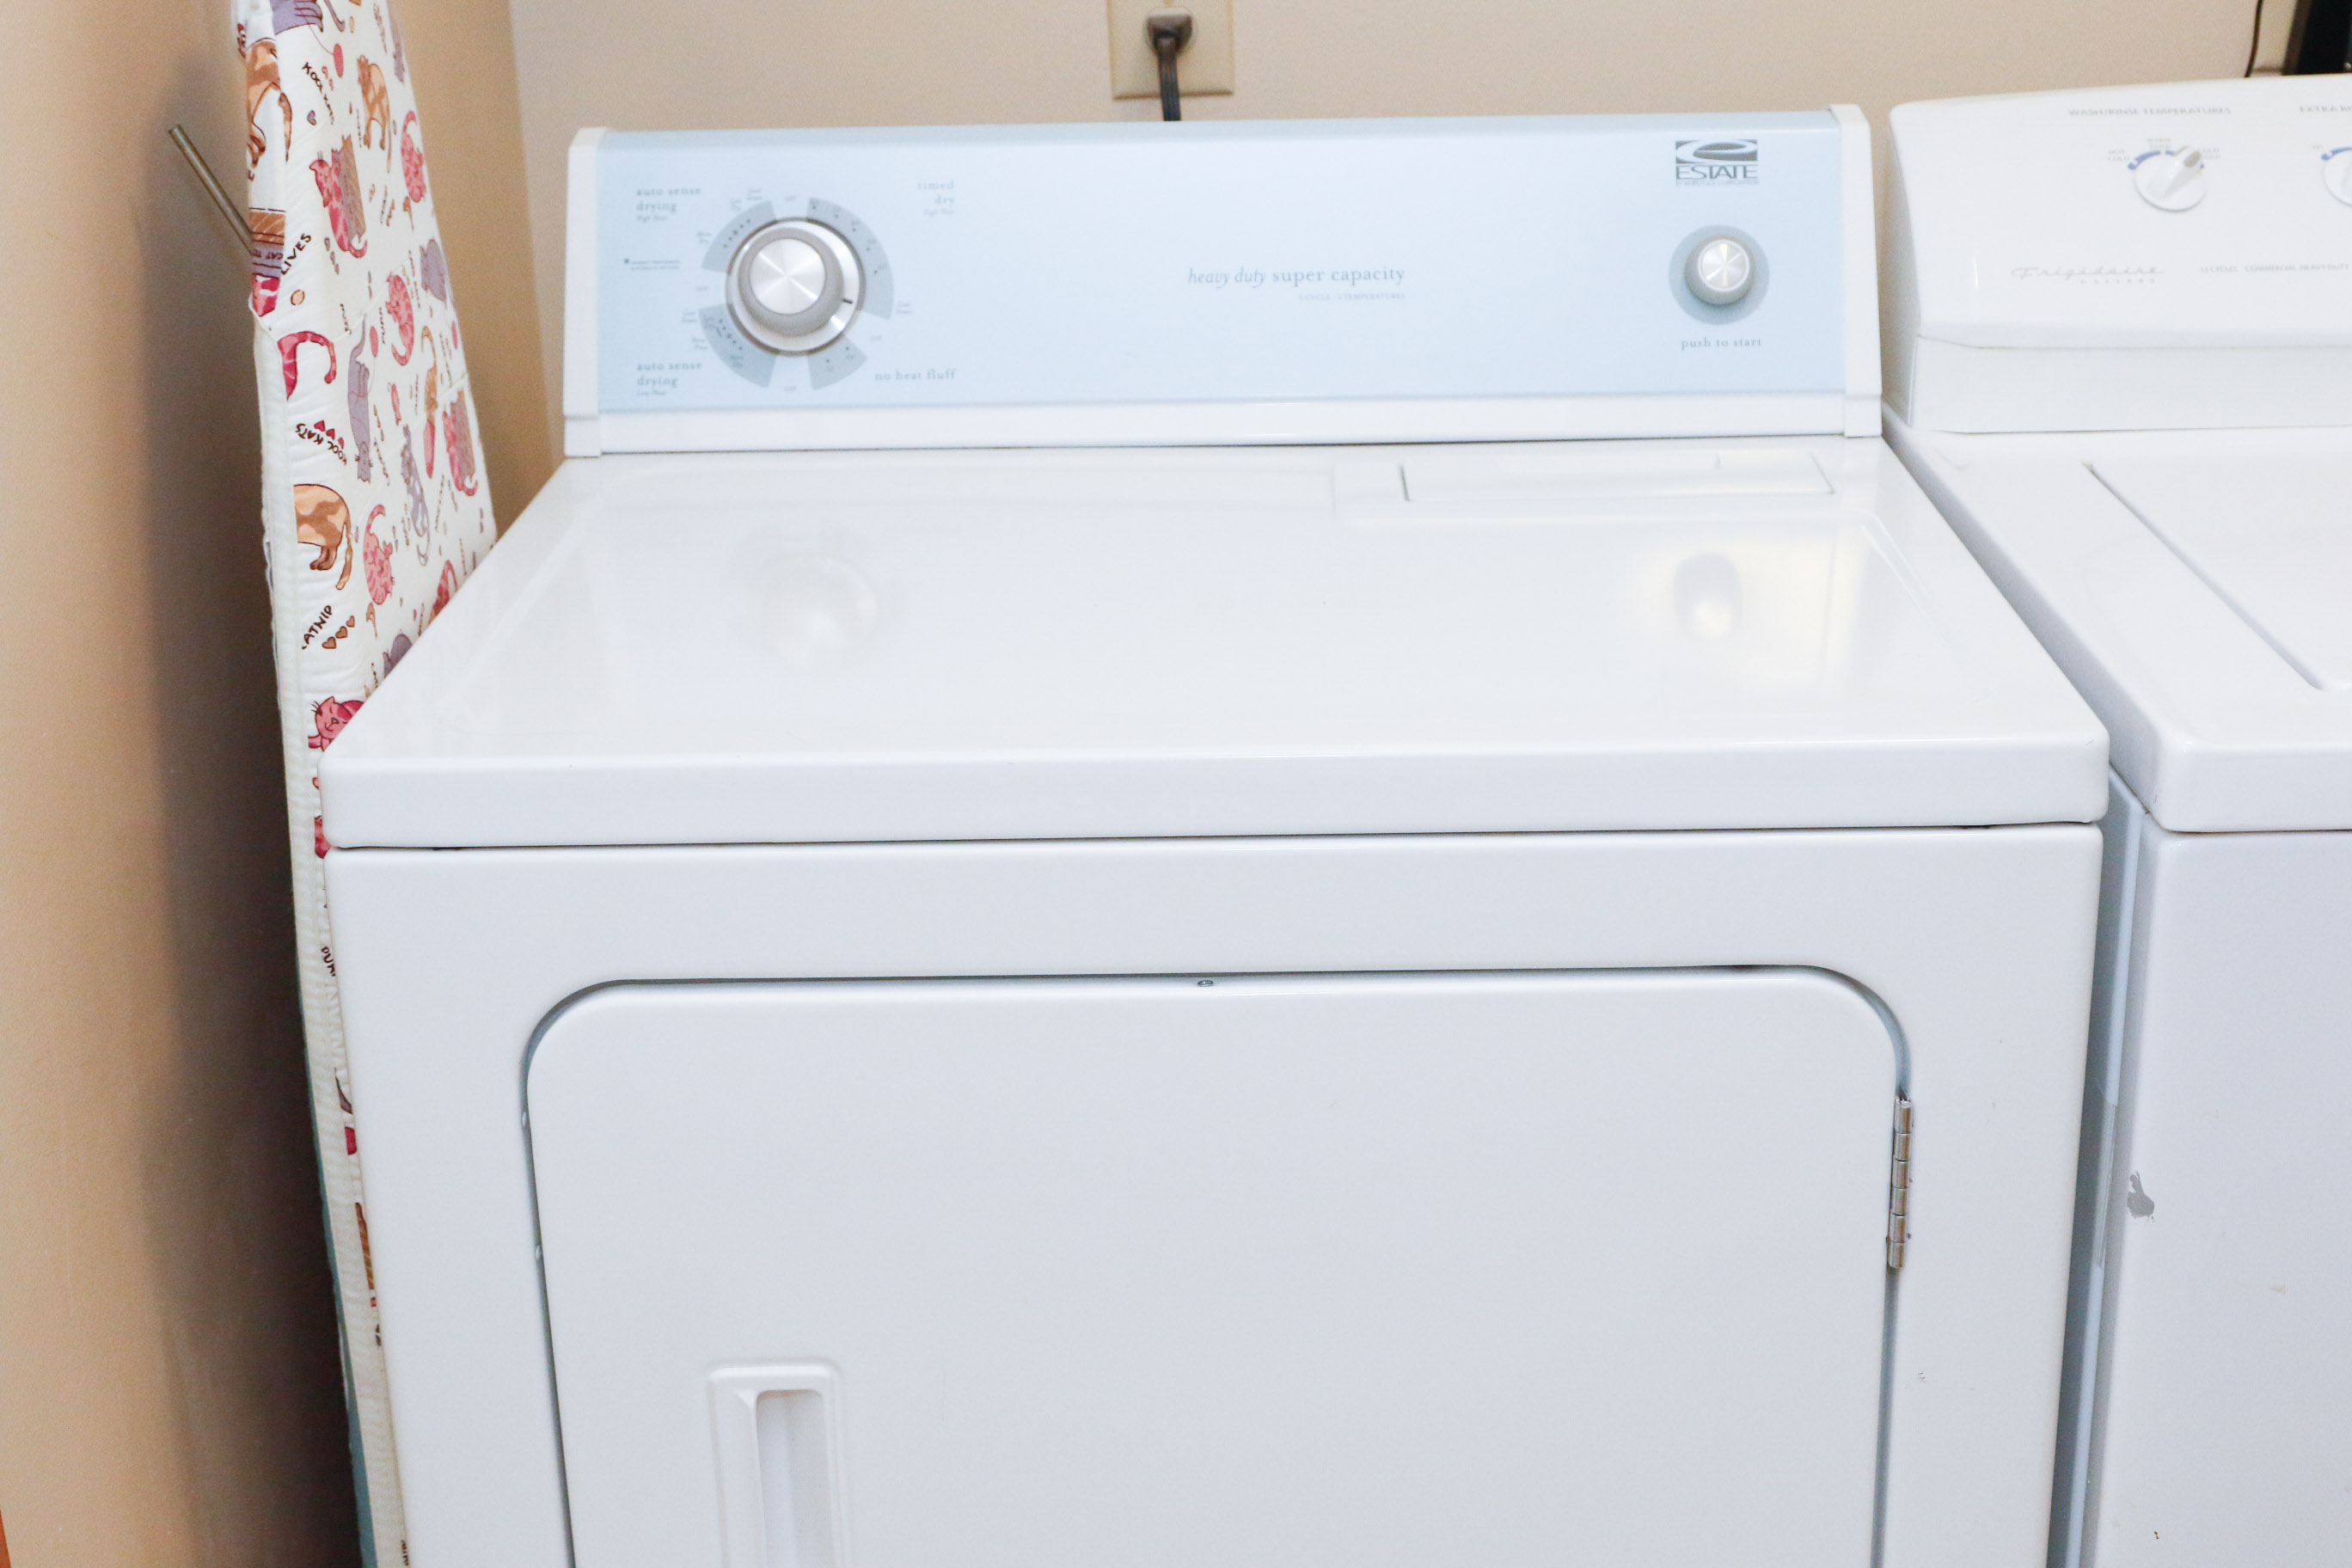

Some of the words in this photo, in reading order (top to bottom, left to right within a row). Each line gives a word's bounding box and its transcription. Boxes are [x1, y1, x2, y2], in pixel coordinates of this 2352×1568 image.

[1675, 164, 1758, 180] ESTATE
[917, 179, 955, 190] timed
[636, 199, 677, 214] drying
[934, 193, 955, 208] dry
[281, 233, 312, 275] LIVES
[1188, 267, 1230, 289] heavy
[1234, 266, 1267, 289] duty
[1272, 268, 1326, 287] super
[1331, 265, 1406, 285] capacity
[2011, 266, 2165, 282] Frigidaire
[1681, 336, 1711, 351] push
[1716, 339, 1729, 347] to
[1733, 338, 1761, 347] start
[636, 362, 665, 371] auto
[667, 362, 702, 371] sense
[895, 369, 922, 380] heat
[927, 368, 956, 379] fluff
[636, 375, 678, 389] drying
[295, 423, 324, 445] KATS
